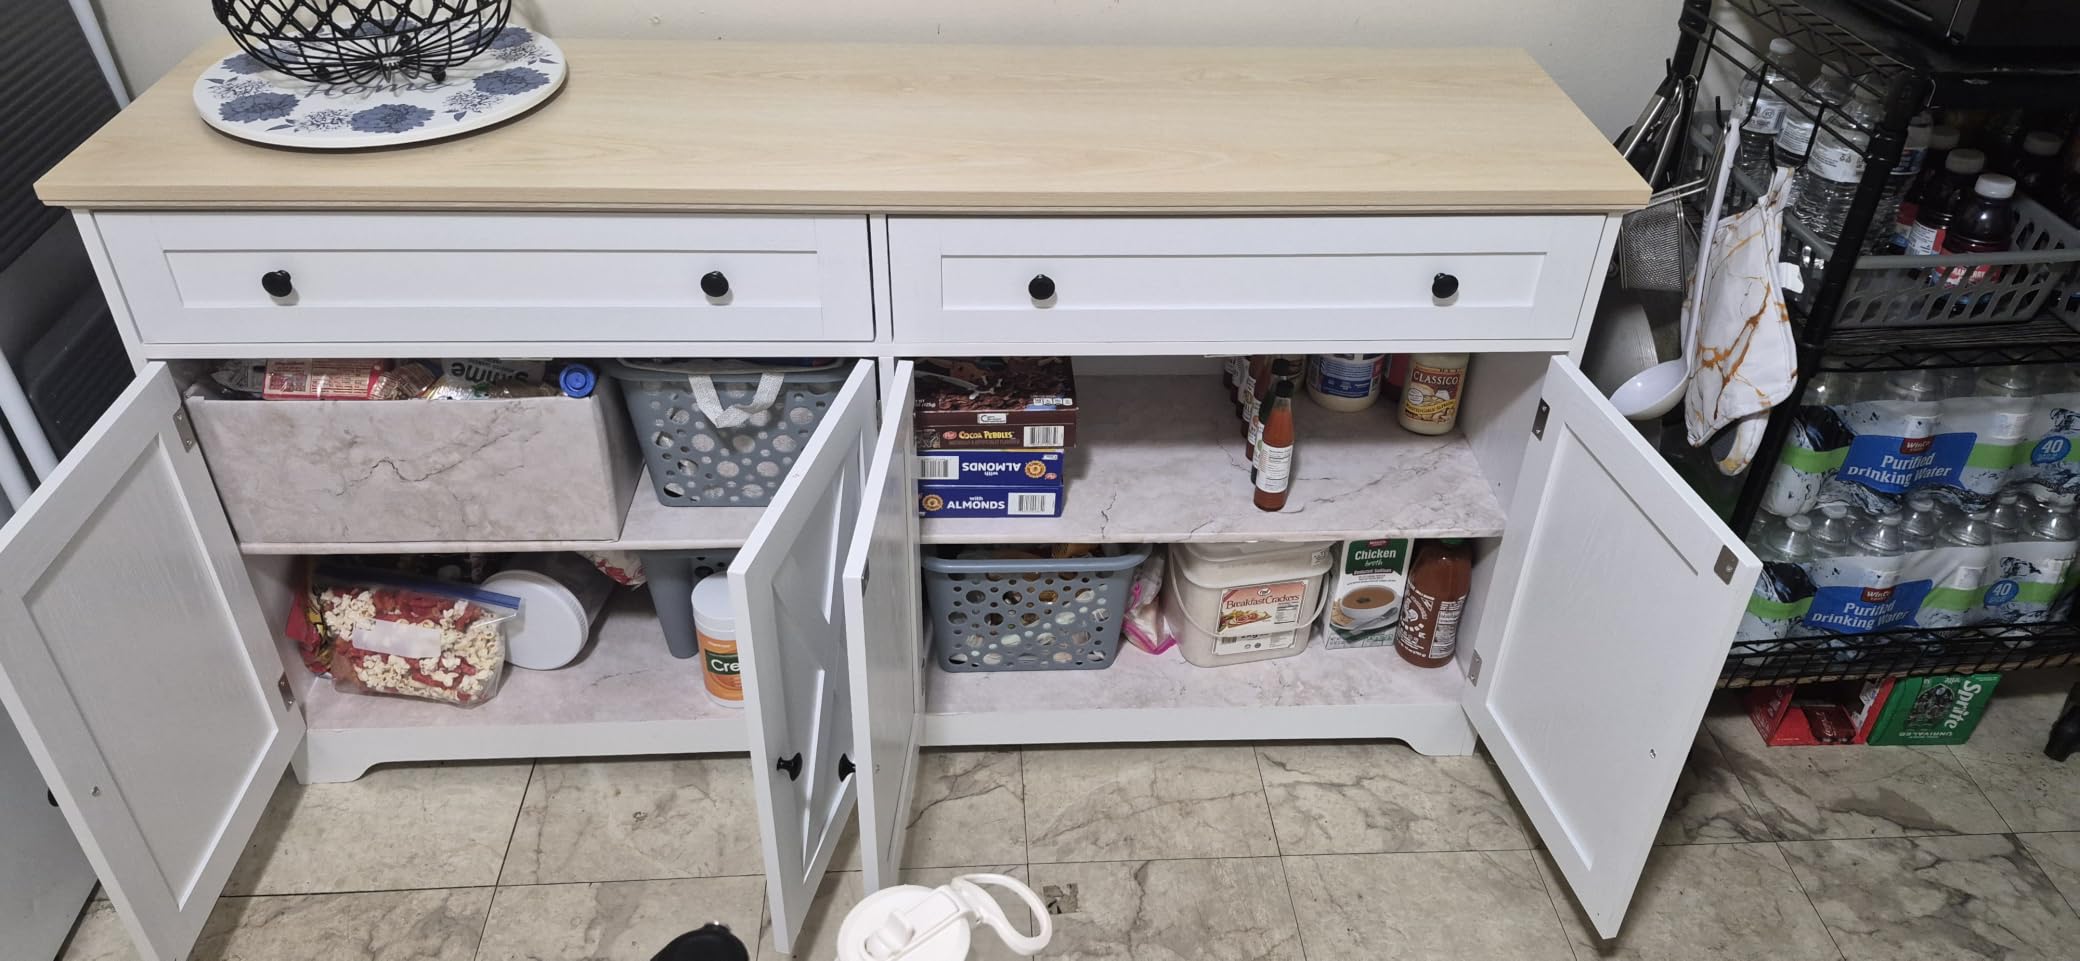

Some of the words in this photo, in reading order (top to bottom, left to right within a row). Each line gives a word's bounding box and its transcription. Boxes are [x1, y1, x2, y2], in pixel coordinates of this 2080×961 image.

[1413, 371, 1459, 385] CLASSICO
[2041, 439, 2064, 454] 40
[962, 462, 1022, 472] ALMONDS
[1880, 453, 1936, 470] Purified
[1847, 466, 1912, 487] Drinking
[1913, 467, 1952, 481] Water
[947, 501, 1005, 509] ALMONDS
[1354, 549, 1397, 561] Chicken
[1993, 582, 2012, 596] 40
[1226, 599, 1265, 610] Breakfast
[1265, 595, 1300, 605] Crackers
[1811, 613, 1875, 630] Drinking
[1944, 679, 1982, 729] Sprite
